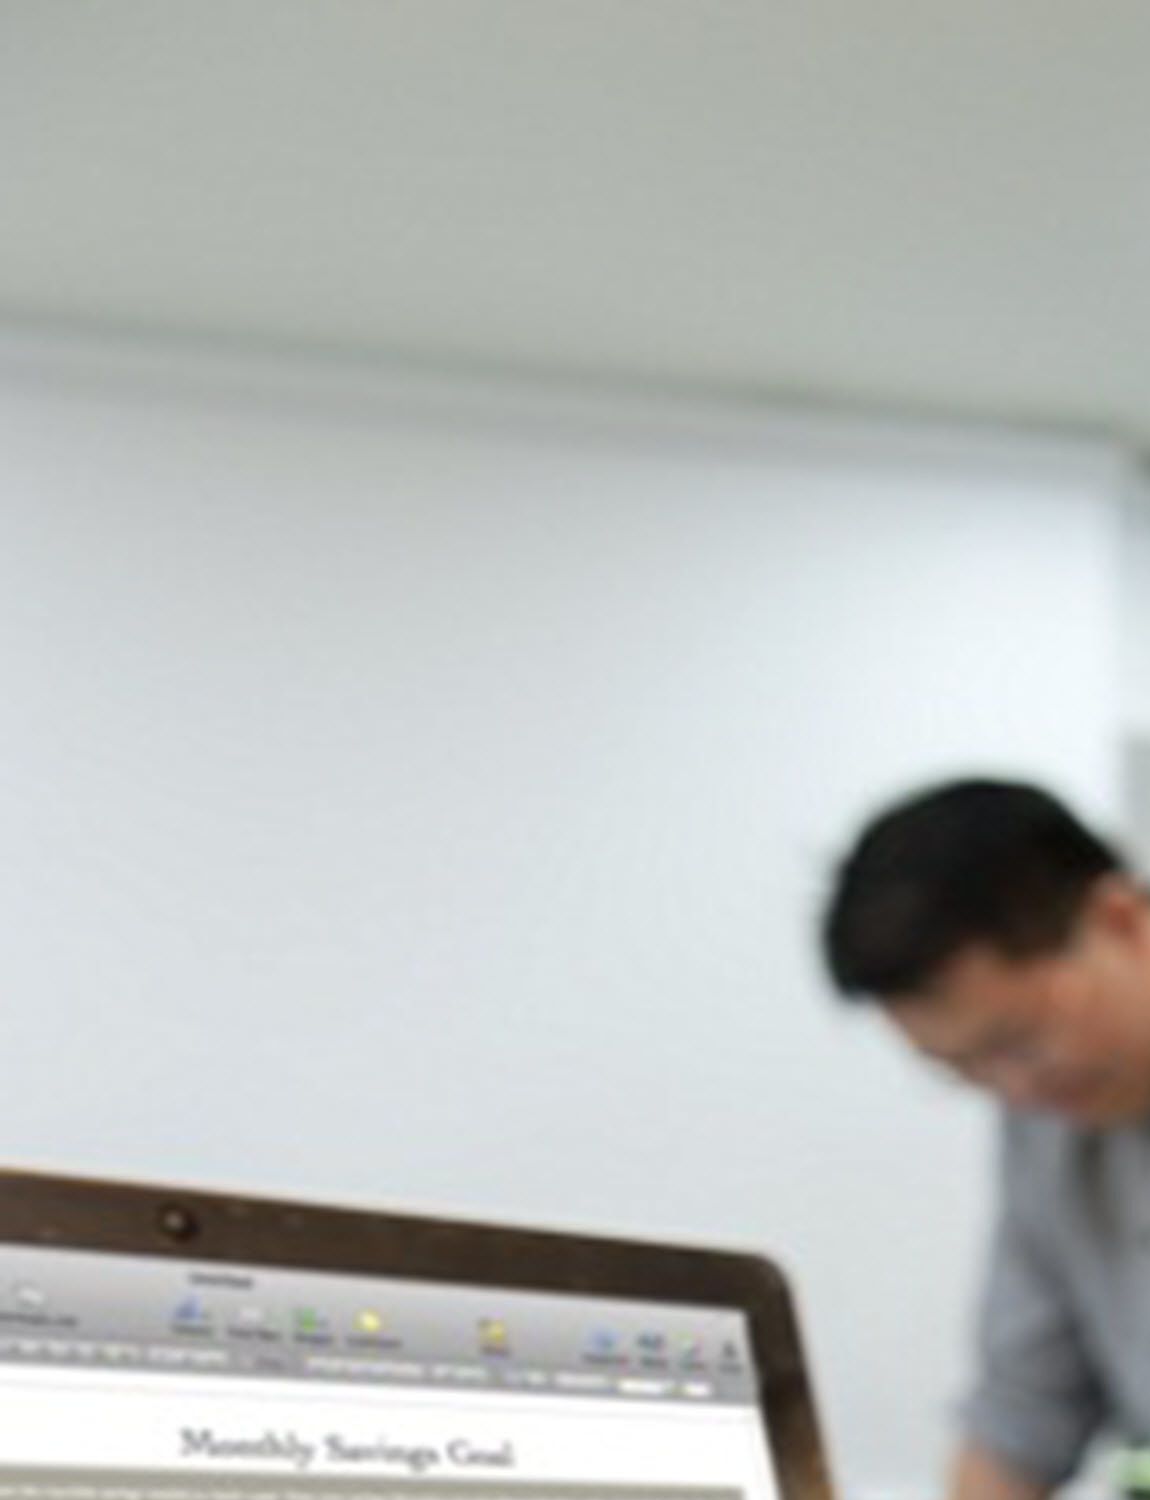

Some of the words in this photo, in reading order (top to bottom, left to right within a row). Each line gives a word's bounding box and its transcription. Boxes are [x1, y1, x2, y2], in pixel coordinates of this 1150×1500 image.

[180, 1427, 313, 1470] Monthly
[324, 1432, 440, 1472] Savings
[447, 1437, 514, 1468] Goal
